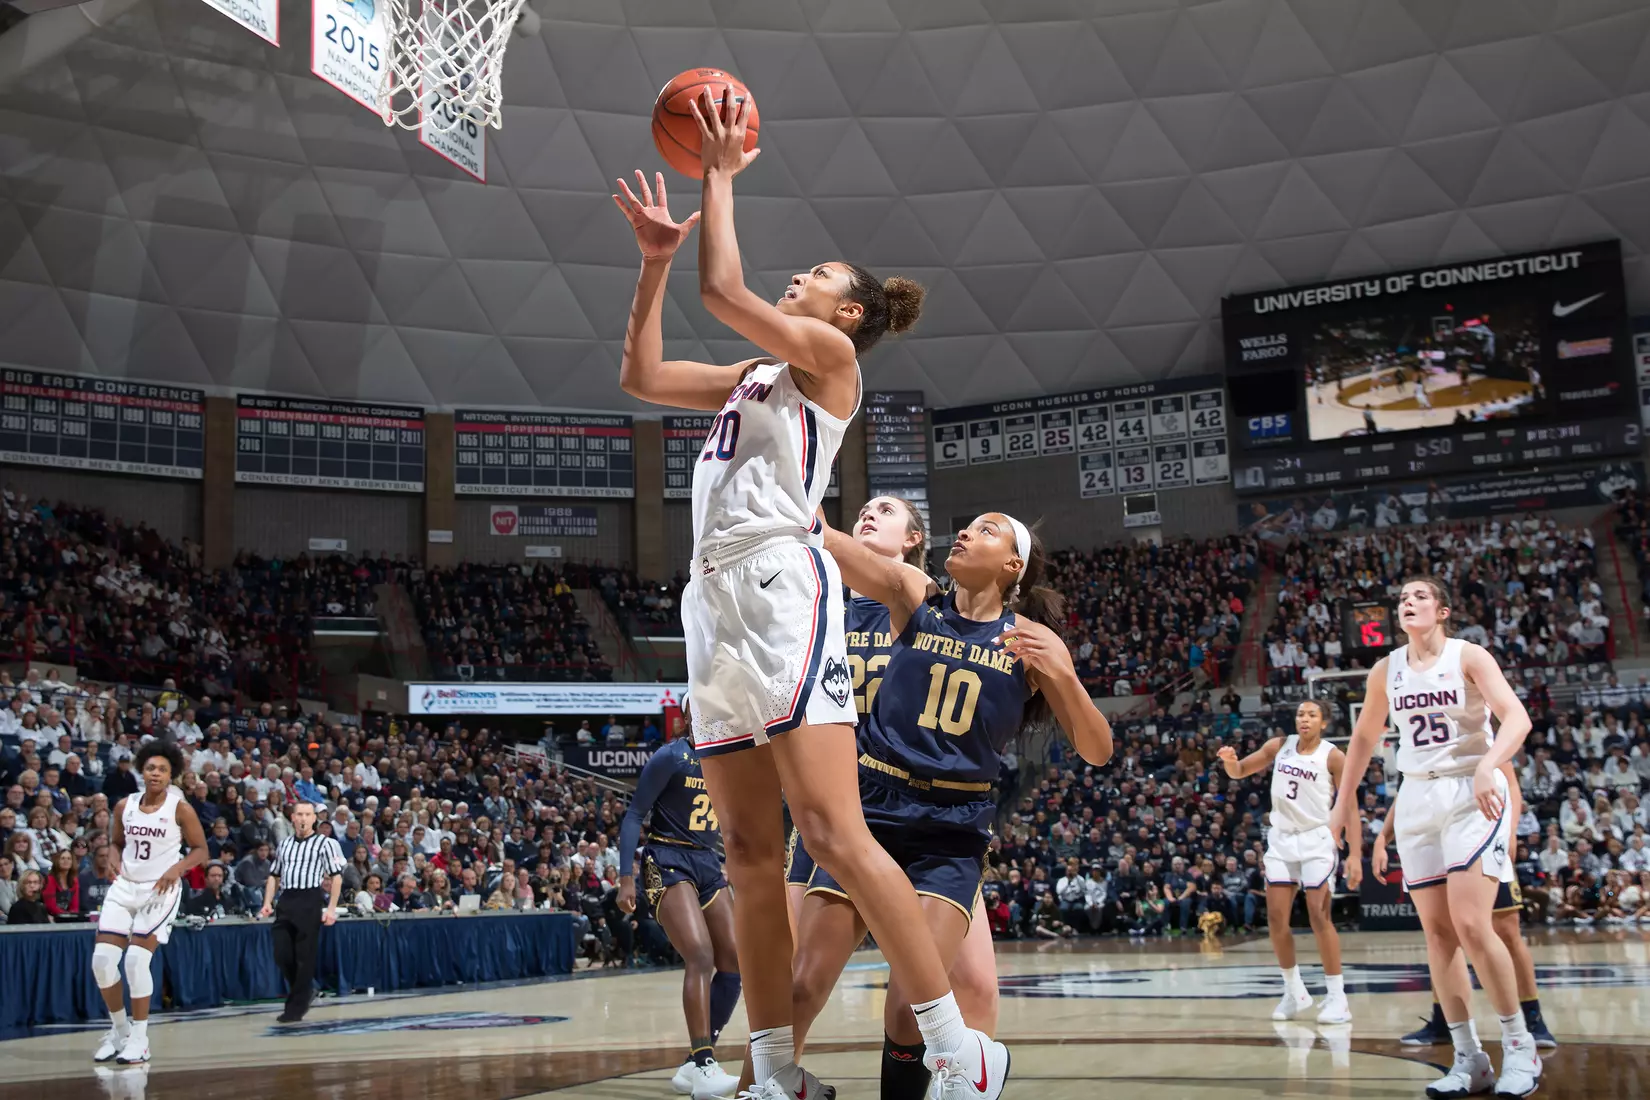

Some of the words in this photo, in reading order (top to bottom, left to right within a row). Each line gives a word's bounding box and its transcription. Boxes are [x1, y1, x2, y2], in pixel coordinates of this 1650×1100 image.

[325, 14, 379, 71] 2015
[327, 48, 379, 91] NATIONAL
[322, 63, 377, 106] CHAMPION
[431, 90, 478, 139] 2016
[428, 133, 479, 173] CHAMPIONS
[1254, 279, 1381, 314] UNIVERSITY
[1385, 274, 1415, 295] OF
[1420, 251, 1583, 289] CONNECTICUT
[1239, 333, 1288, 349] WELLS
[1242, 345, 1288, 361] FARGO
[5, 371, 33, 384] BIG
[42, 375, 86, 389] EAST
[95, 381, 200, 401] CONFERENCE
[728, 382, 773, 403] ONN
[72, 392, 121, 404] SEASON
[128, 397, 200, 412] CHAMPIONS
[993, 402, 1032, 413] UCONN
[1038, 394, 1088, 407] HUSKIES
[1094, 391, 1109, 399] OF
[1115, 385, 1155, 396] HONOR
[255, 410, 334, 422] TOURNAMENT
[340, 415, 408, 428] CHAMPIONS
[371, 408, 420, 418] CONFERENCE
[463, 413, 508, 422] NATIONAL
[510, 415, 561, 424] INVITATION
[565, 416, 625, 425] TOURNAMENT
[1194, 409, 1222, 428] 42
[504, 424, 585, 435] APPEARANCES
[672, 418, 711, 427] NCAA
[1118, 419, 1145, 437] 44
[1248, 414, 1287, 431] CBS
[401, 431, 421, 444] 2011
[485, 434, 504, 447] 1974
[511, 435, 529, 448] 1975
[672, 429, 708, 437] TOURN
[702, 410, 741, 462] 20
[1044, 428, 1070, 447] 25
[1082, 424, 1108, 442] 42
[943, 443, 957, 459] C
[981, 439, 991, 455] 9
[1009, 433, 1034, 452] 22
[3, 453, 83, 467] CONNECTICUT
[127, 464, 196, 476] BASKETBALL
[586, 455, 605, 468] 2015
[1084, 470, 1110, 489] 24
[1124, 466, 1145, 484] 13
[1160, 462, 1185, 480] 22
[241, 473, 314, 485] CONNECTICUT
[354, 480, 418, 491] BASKETBALL
[460, 485, 528, 494] CONNECTICUT
[568, 488, 630, 497] BASKETBALL
[544, 508, 573, 516] 1988
[496, 516, 515, 527] NIT
[845, 632, 868, 647] TRE
[873, 632, 893, 647] DA
[912, 631, 966, 659] NOTRE
[969, 643, 1014, 675] DAME
[437, 688, 496, 698] BellSimons
[847, 654, 892, 714] 22
[917, 663, 982, 736] 10
[1394, 690, 1458, 711] UCONN
[1409, 712, 1450, 746] 25
[588, 751, 653, 767] UCONN
[1277, 762, 1318, 782] UCONN
[1286, 781, 1298, 800] 3
[126, 826, 166, 838] UCONN
[134, 840, 151, 861] 13
[1361, 904, 1419, 917] TRAVEL
